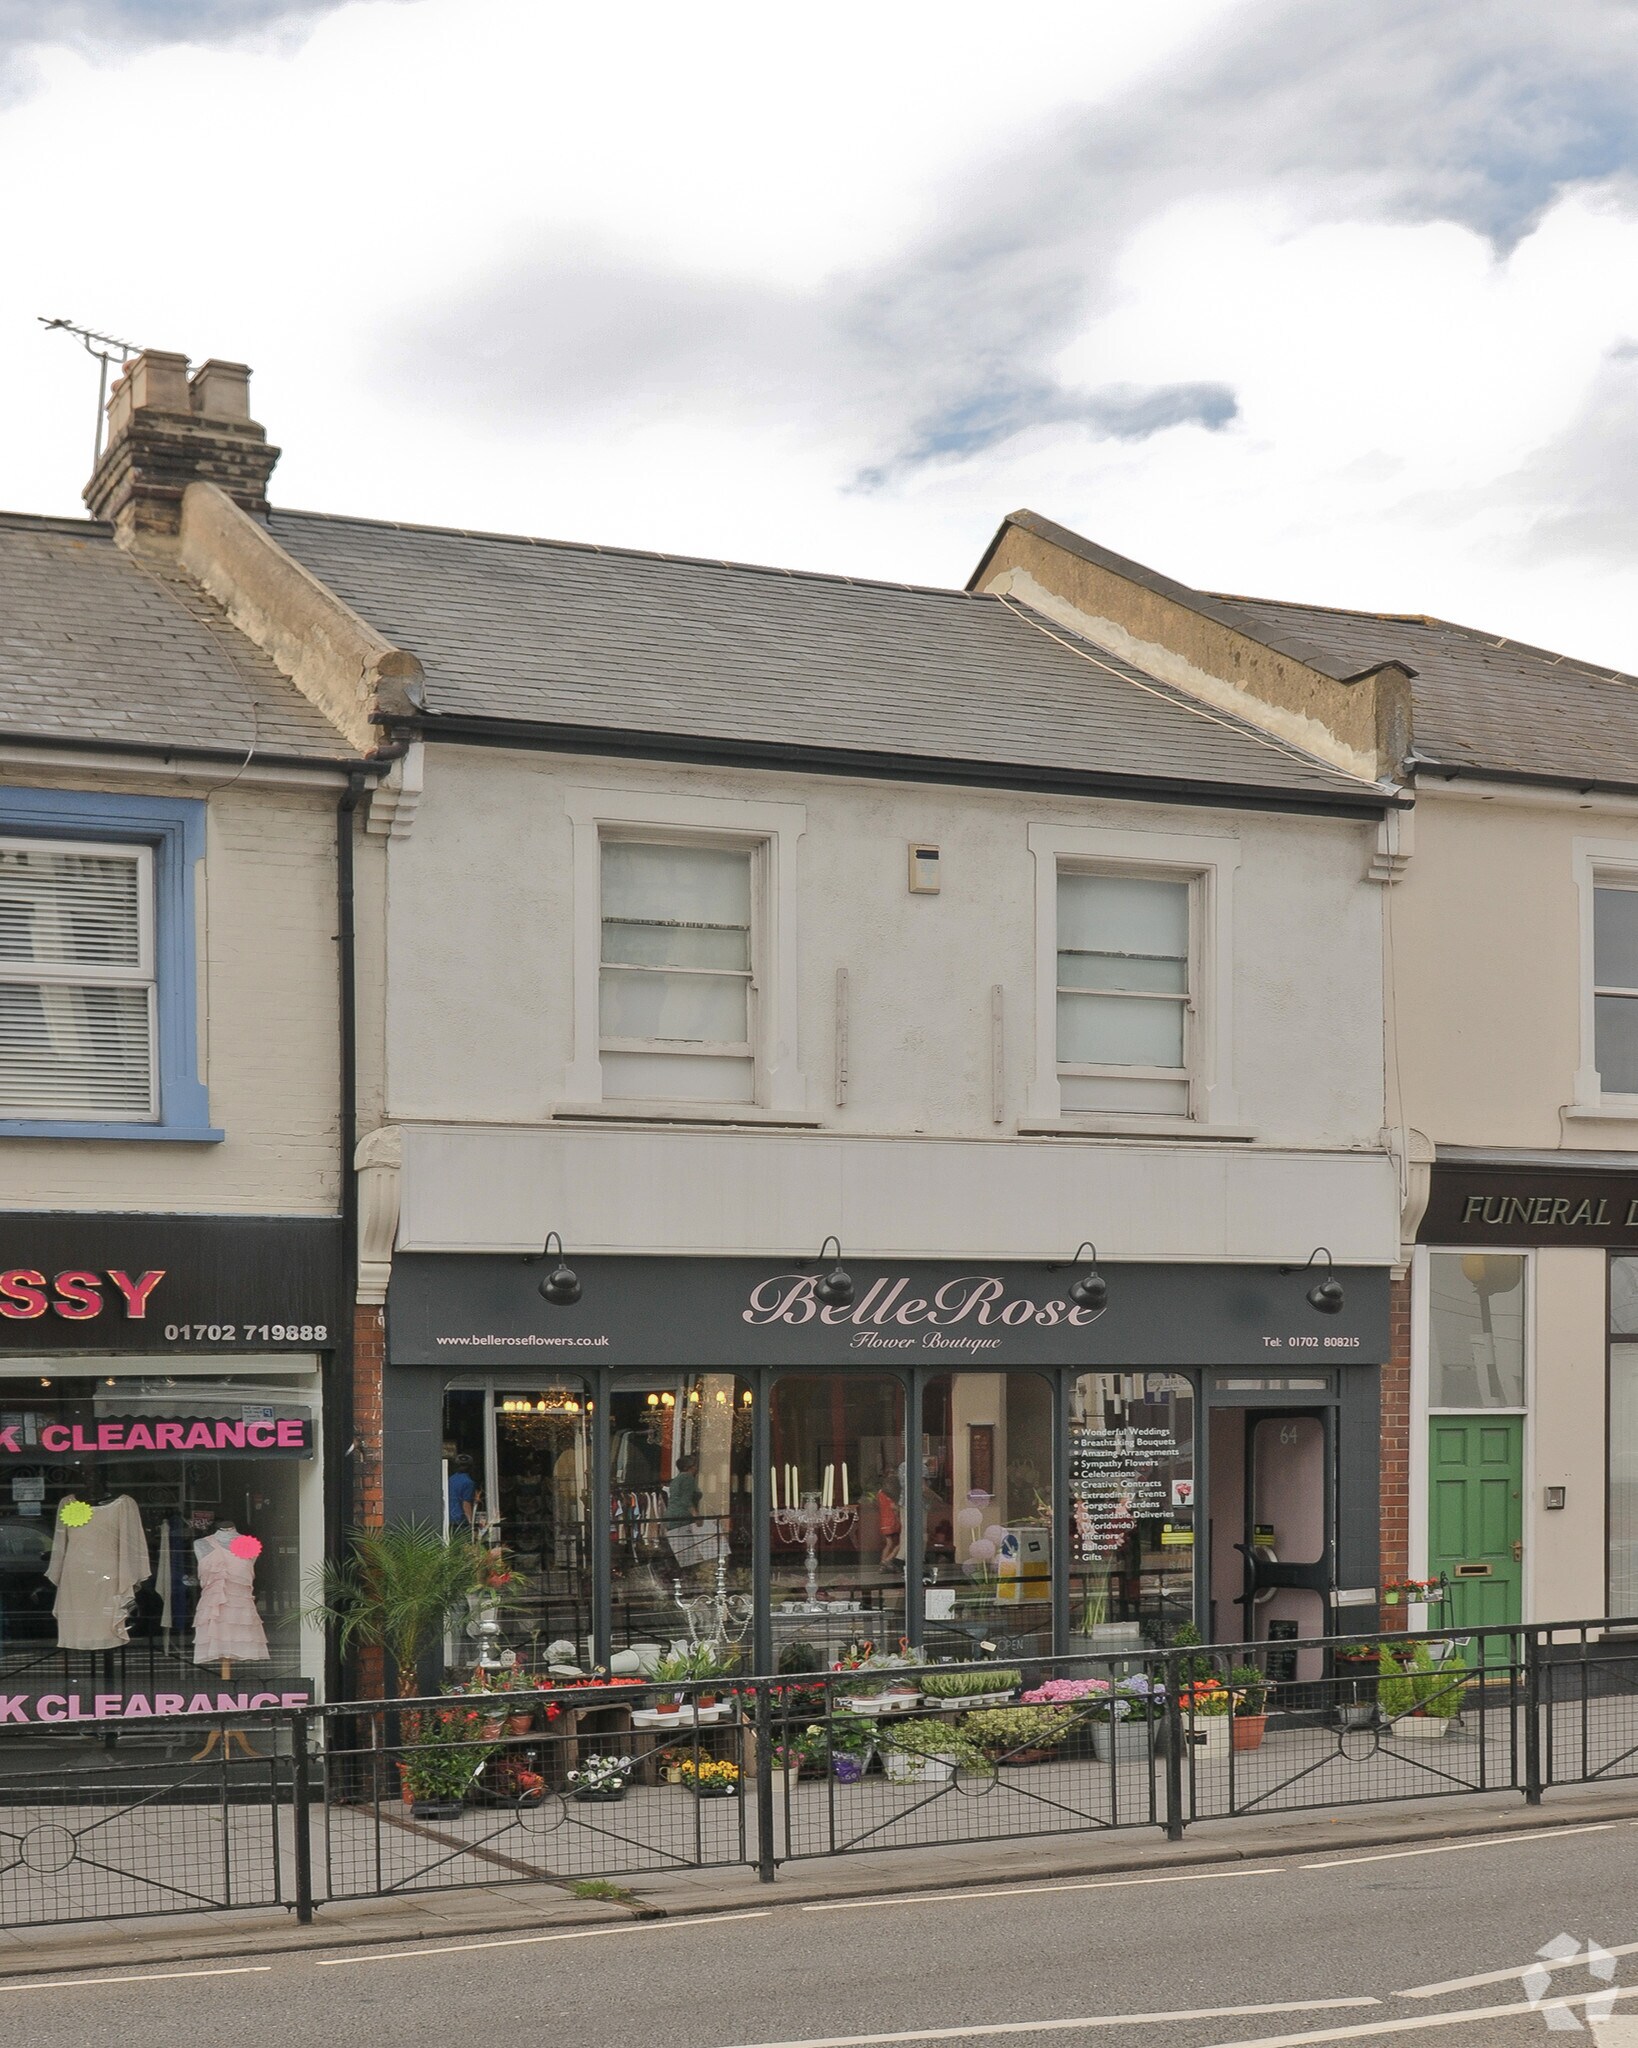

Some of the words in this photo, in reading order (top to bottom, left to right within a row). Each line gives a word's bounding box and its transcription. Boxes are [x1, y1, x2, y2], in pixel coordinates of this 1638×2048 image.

[1462, 1196, 1611, 1225] FUNERAL
[0, 1269, 167, 1320] SSY
[164, 1324, 236, 1341] 01702
[243, 1324, 328, 1341] 719888
[436, 1334, 609, 1346] www.belleroseflowers.co.uk
[849, 1331, 916, 1349] Flower
[922, 1331, 1002, 1355] Boutique
[1262, 1336, 1282, 1347] Tel:
[1288, 1336, 1319, 1347] 01702
[1323, 1336, 1360, 1347] 808215
[41, 1421, 304, 1451] CLEARANCE
[1081, 1428, 1127, 1437] Wonderful
[1128, 1428, 1170, 1437] Weddings
[1280, 1425, 1297, 1444] 64
[1081, 1439, 1135, 1448] Breathtaking
[1136, 1438, 1176, 1447] Bouquets
[1081, 1449, 1118, 1458] Amazing
[1120, 1449, 1179, 1458] Arrangements
[1081, 1460, 1122, 1469] Sympathy
[1124, 1459, 1159, 1468] Flowers
[1081, 1470, 1135, 1479] Celebrations
[1081, 1481, 1118, 1489] Creative
[1120, 1480, 1161, 1488] Contracts
[1138, 1489, 1166, 1498] Events
[1081, 1501, 1122, 1511] Gorgeous
[1125, 1500, 1160, 1509] Gardens
[1081, 1512, 1131, 1521] Dependable
[1133, 1510, 1174, 1519] Deliveries
[1081, 1532, 1120, 1541] Interiors
[1081, 1542, 1118, 1551] Balloons
[1081, 1553, 1102, 1561] Gifts
[0, 1695, 30, 1722] K
